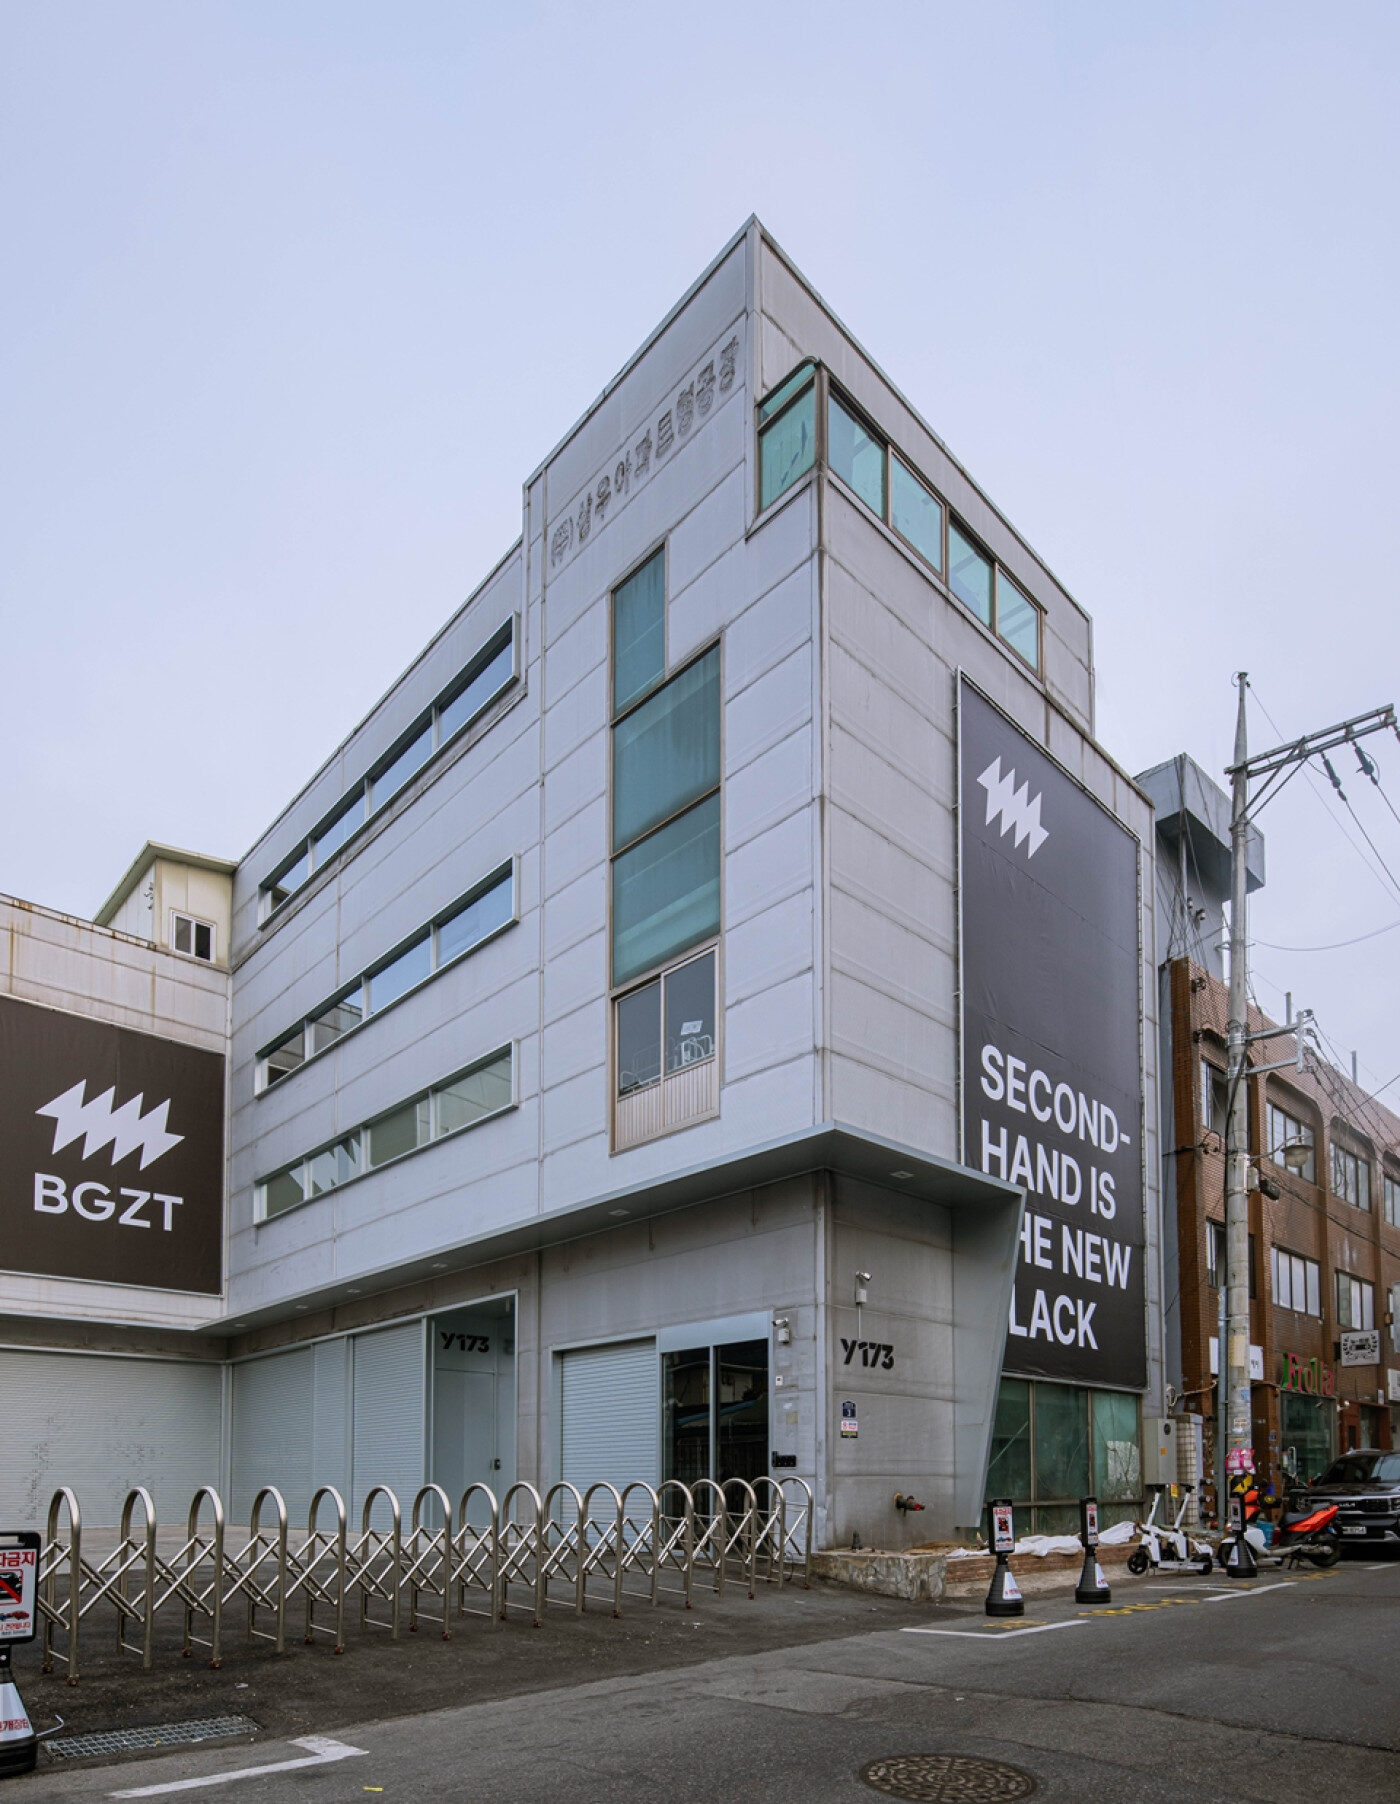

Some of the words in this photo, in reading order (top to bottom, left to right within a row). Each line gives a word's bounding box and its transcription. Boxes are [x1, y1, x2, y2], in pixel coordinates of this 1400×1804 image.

[980, 1044, 1131, 1154] SECOND-
[33, 1171, 185, 1232] BGZT
[981, 1119, 1083, 1206] HAND
[1089, 1166, 1117, 1220] IS
[1018, 1211, 1053, 1270] HE
[1062, 1223, 1132, 1290] NEW
[1008, 1284, 1099, 1350] LACK
